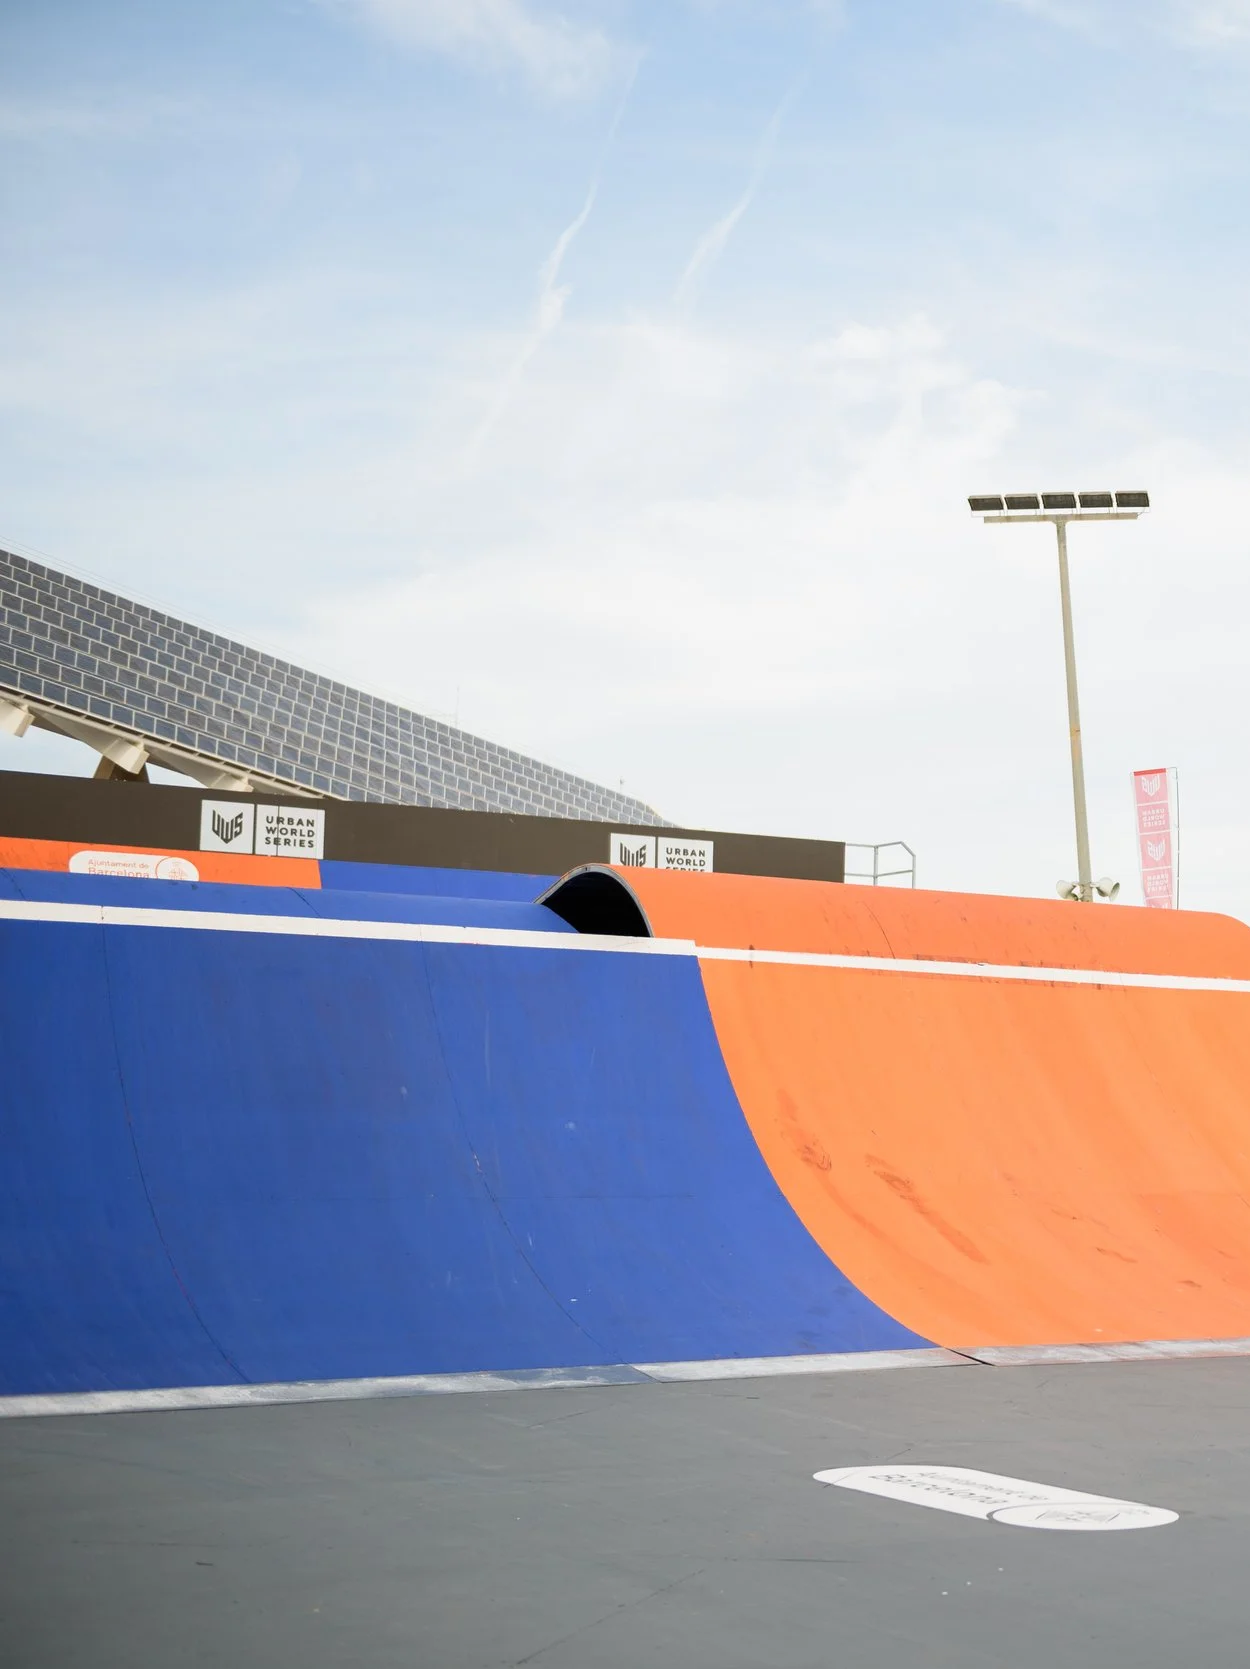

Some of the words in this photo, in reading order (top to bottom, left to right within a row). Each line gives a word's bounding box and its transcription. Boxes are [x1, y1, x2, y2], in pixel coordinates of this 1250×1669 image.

[266, 815, 316, 828] URBAN
[265, 825, 316, 839] WORLD
[264, 836, 315, 849] SERIES
[666, 848, 705, 857] URBAN
[666, 857, 706, 867] WORLD
